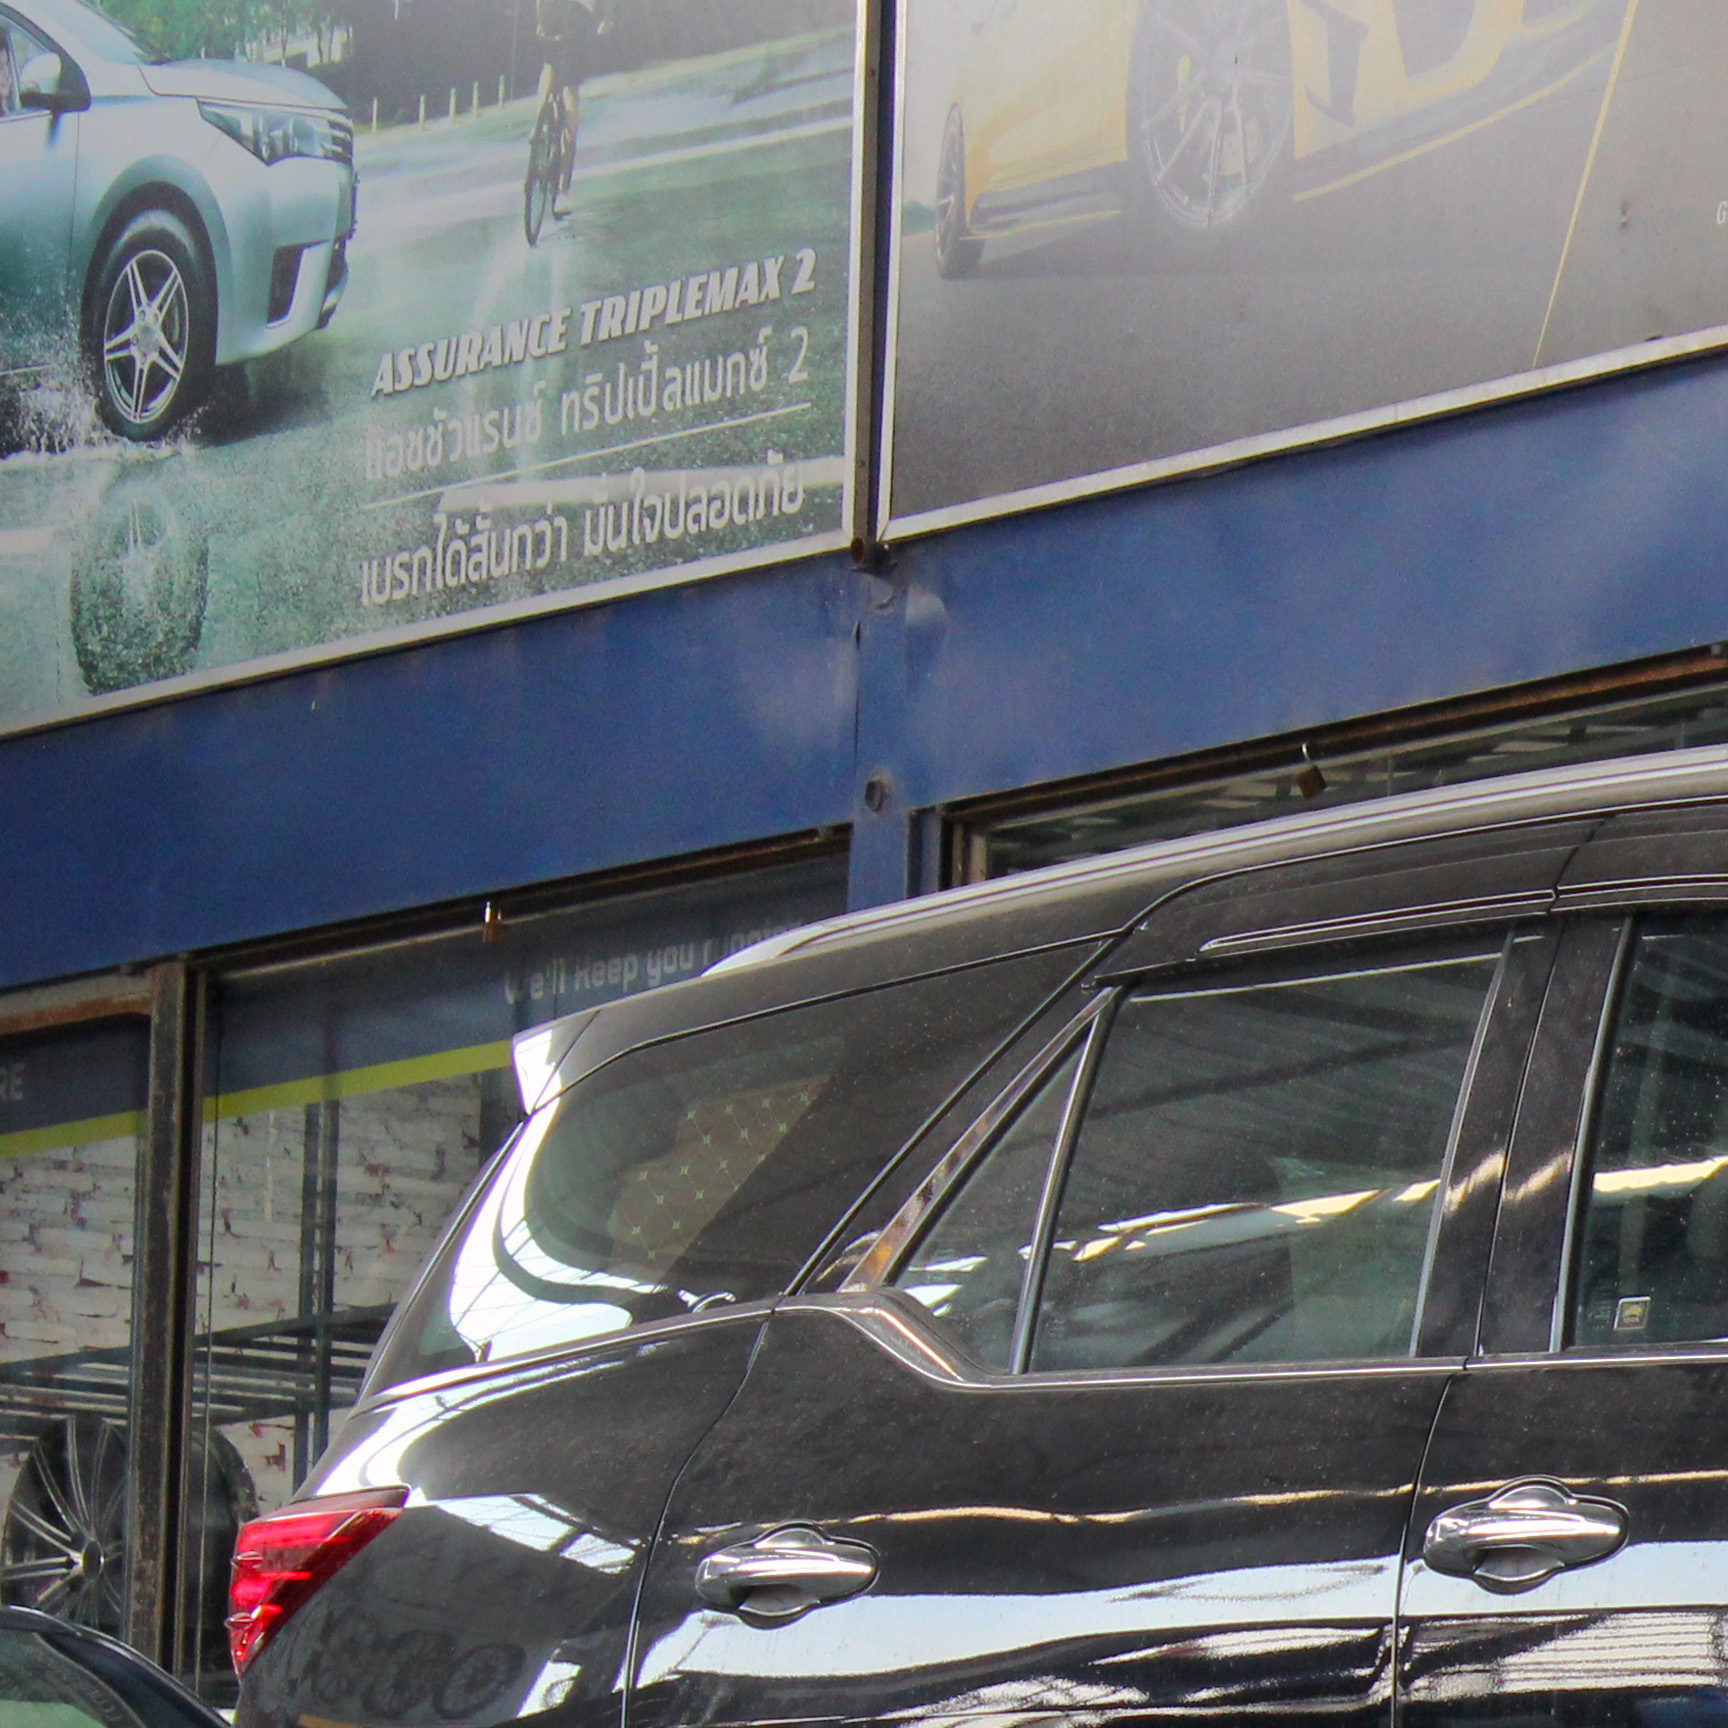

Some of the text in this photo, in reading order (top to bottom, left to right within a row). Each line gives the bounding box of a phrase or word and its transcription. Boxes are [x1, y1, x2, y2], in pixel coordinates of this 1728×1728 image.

[370, 248, 817, 397] ASSURANCE TRIPLEMAX 2
[787, 326, 810, 384] 2
